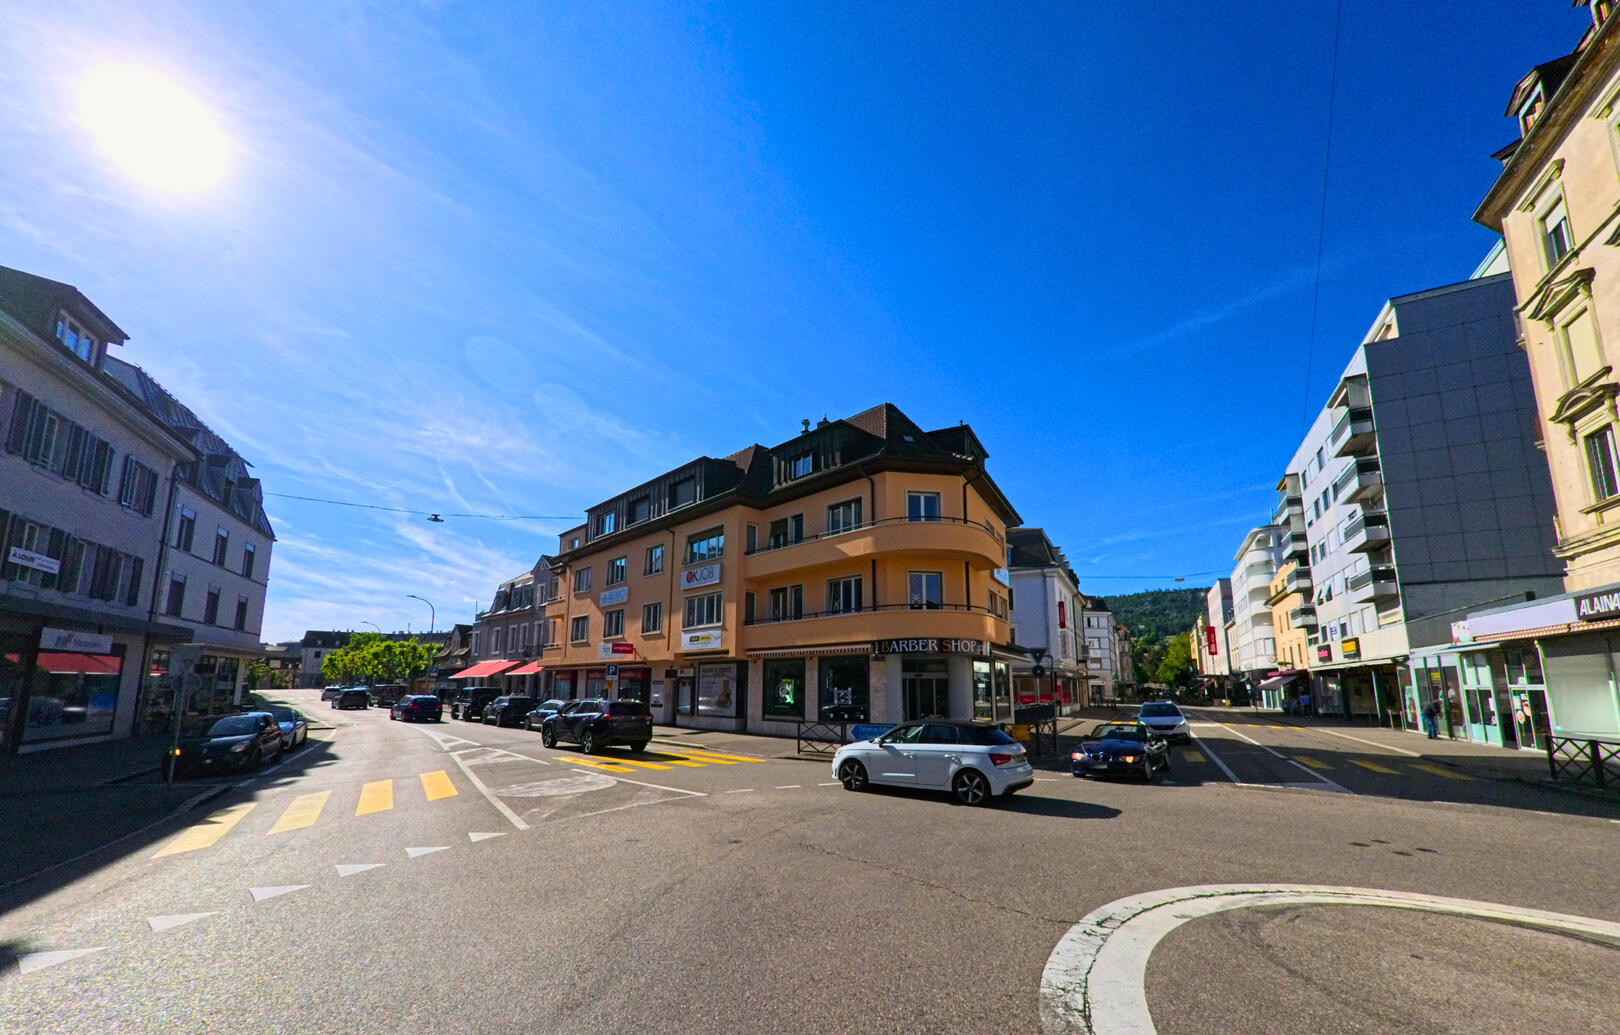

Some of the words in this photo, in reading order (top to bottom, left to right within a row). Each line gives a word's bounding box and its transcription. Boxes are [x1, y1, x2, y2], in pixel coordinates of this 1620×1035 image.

[881, 639, 938, 653] BARBER
[942, 639, 977, 653] SHOP
[609, 665, 616, 674] P
